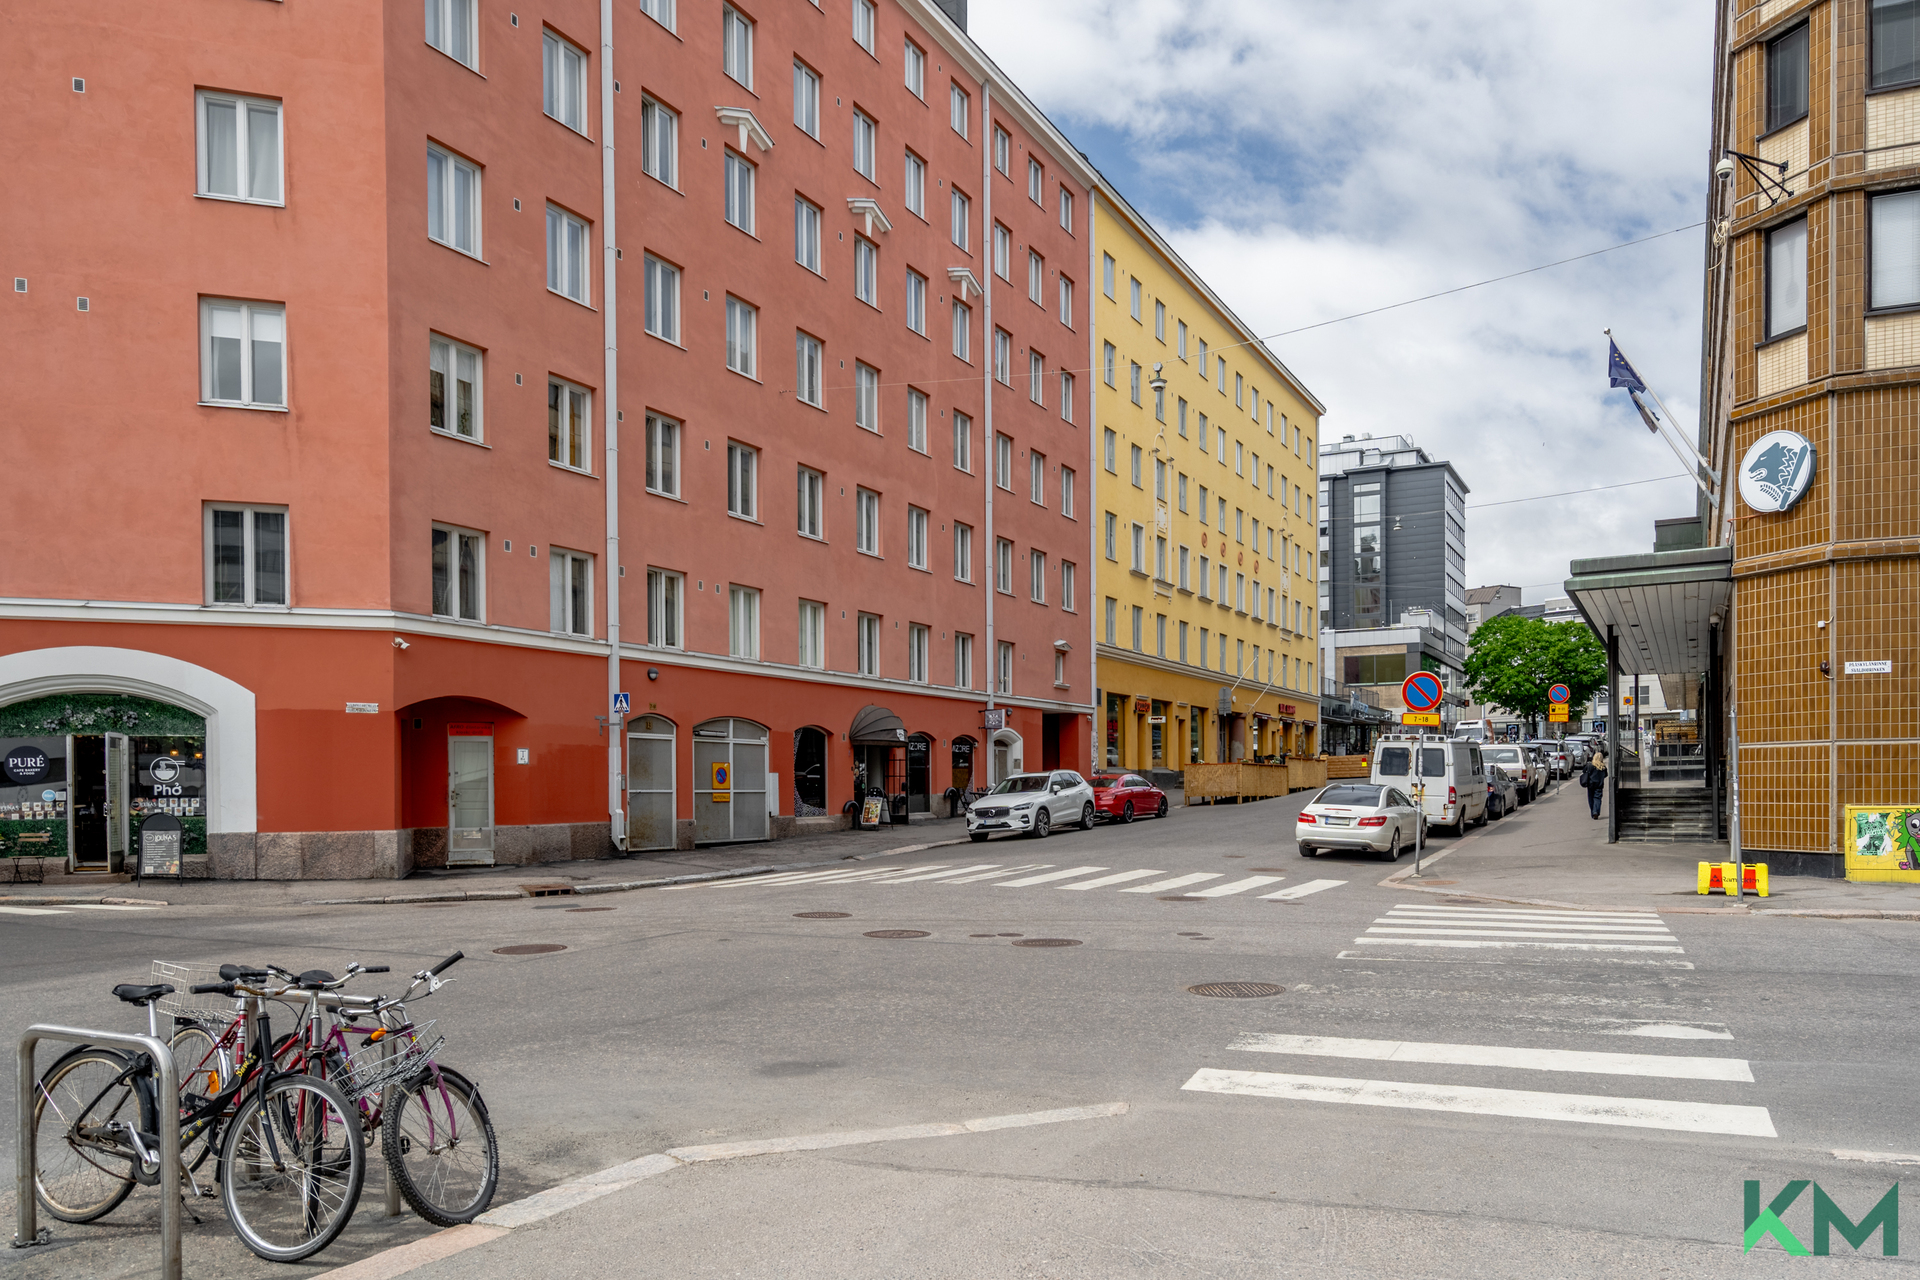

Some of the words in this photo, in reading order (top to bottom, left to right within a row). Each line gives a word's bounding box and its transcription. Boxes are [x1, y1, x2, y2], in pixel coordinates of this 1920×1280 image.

[9, 755, 45, 768] PURÉ
[153, 782, 183, 796] Phở
[154, 834, 177, 843] LOUNAS
[1721, 876, 1760, 884] Ramdden
